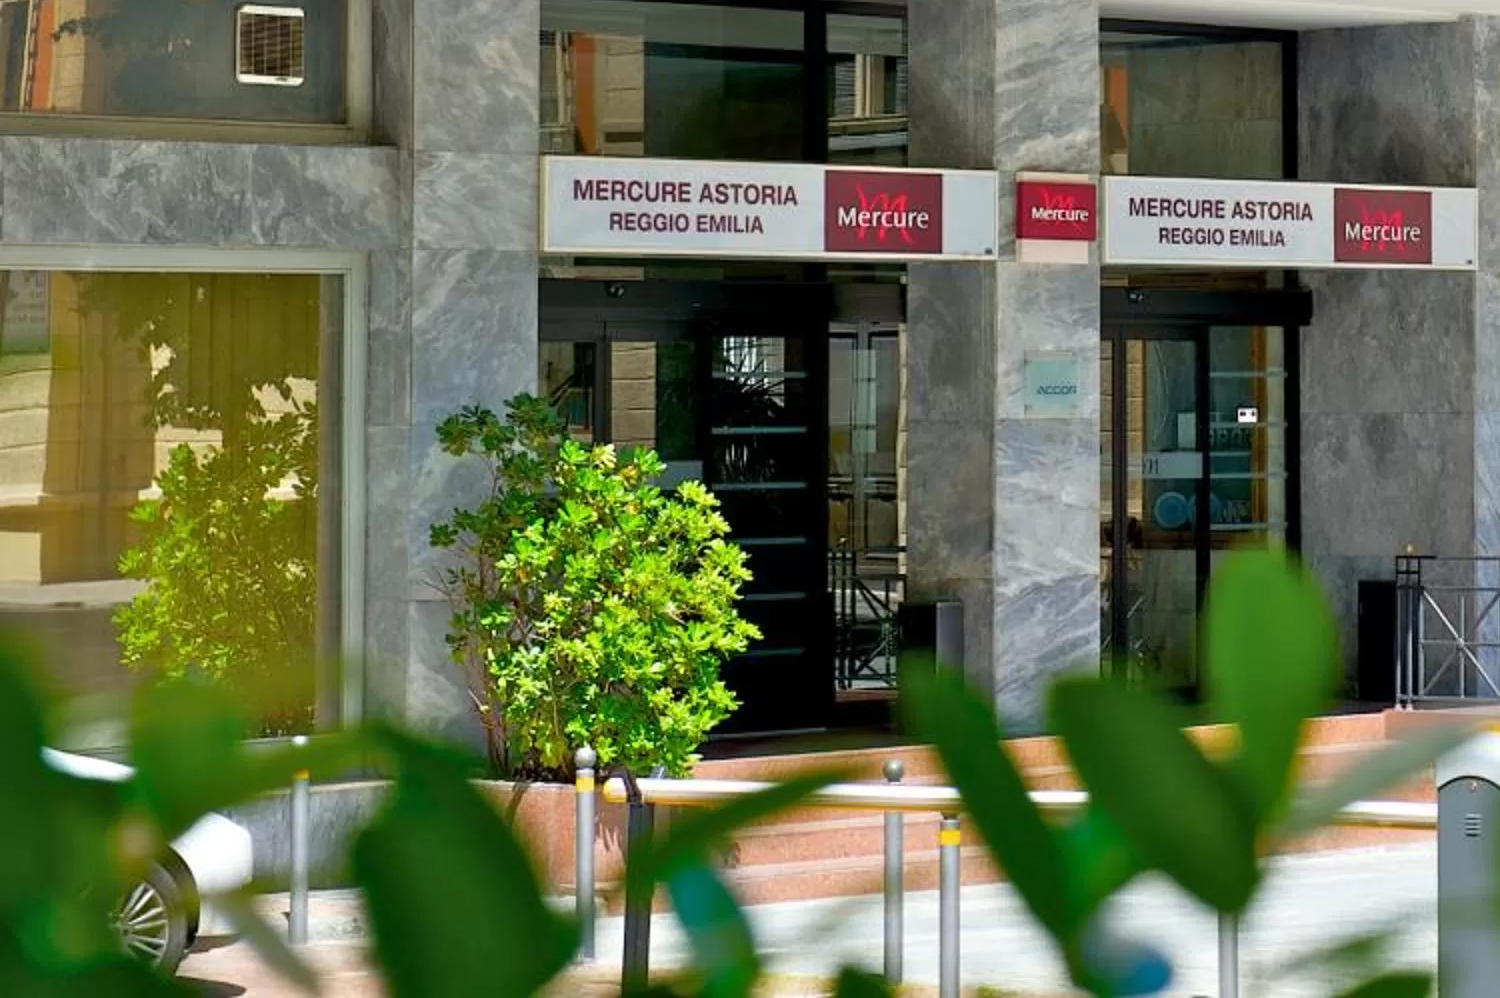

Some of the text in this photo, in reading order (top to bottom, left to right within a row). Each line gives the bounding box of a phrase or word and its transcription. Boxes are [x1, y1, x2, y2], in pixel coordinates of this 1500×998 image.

[573, 179, 799, 206] MERCURE ASTORIA
[837, 206, 929, 229] Mercure
[1031, 205, 1089, 222] Mercure
[1128, 197, 1313, 221] MERCURE ASTORIA
[609, 212, 764, 235] REGGIO EMILIA
[1345, 222, 1421, 242] Mercure
[1158, 227, 1286, 248] REGGIO EMILIA
[1036, 385, 1078, 395] ACCOR
